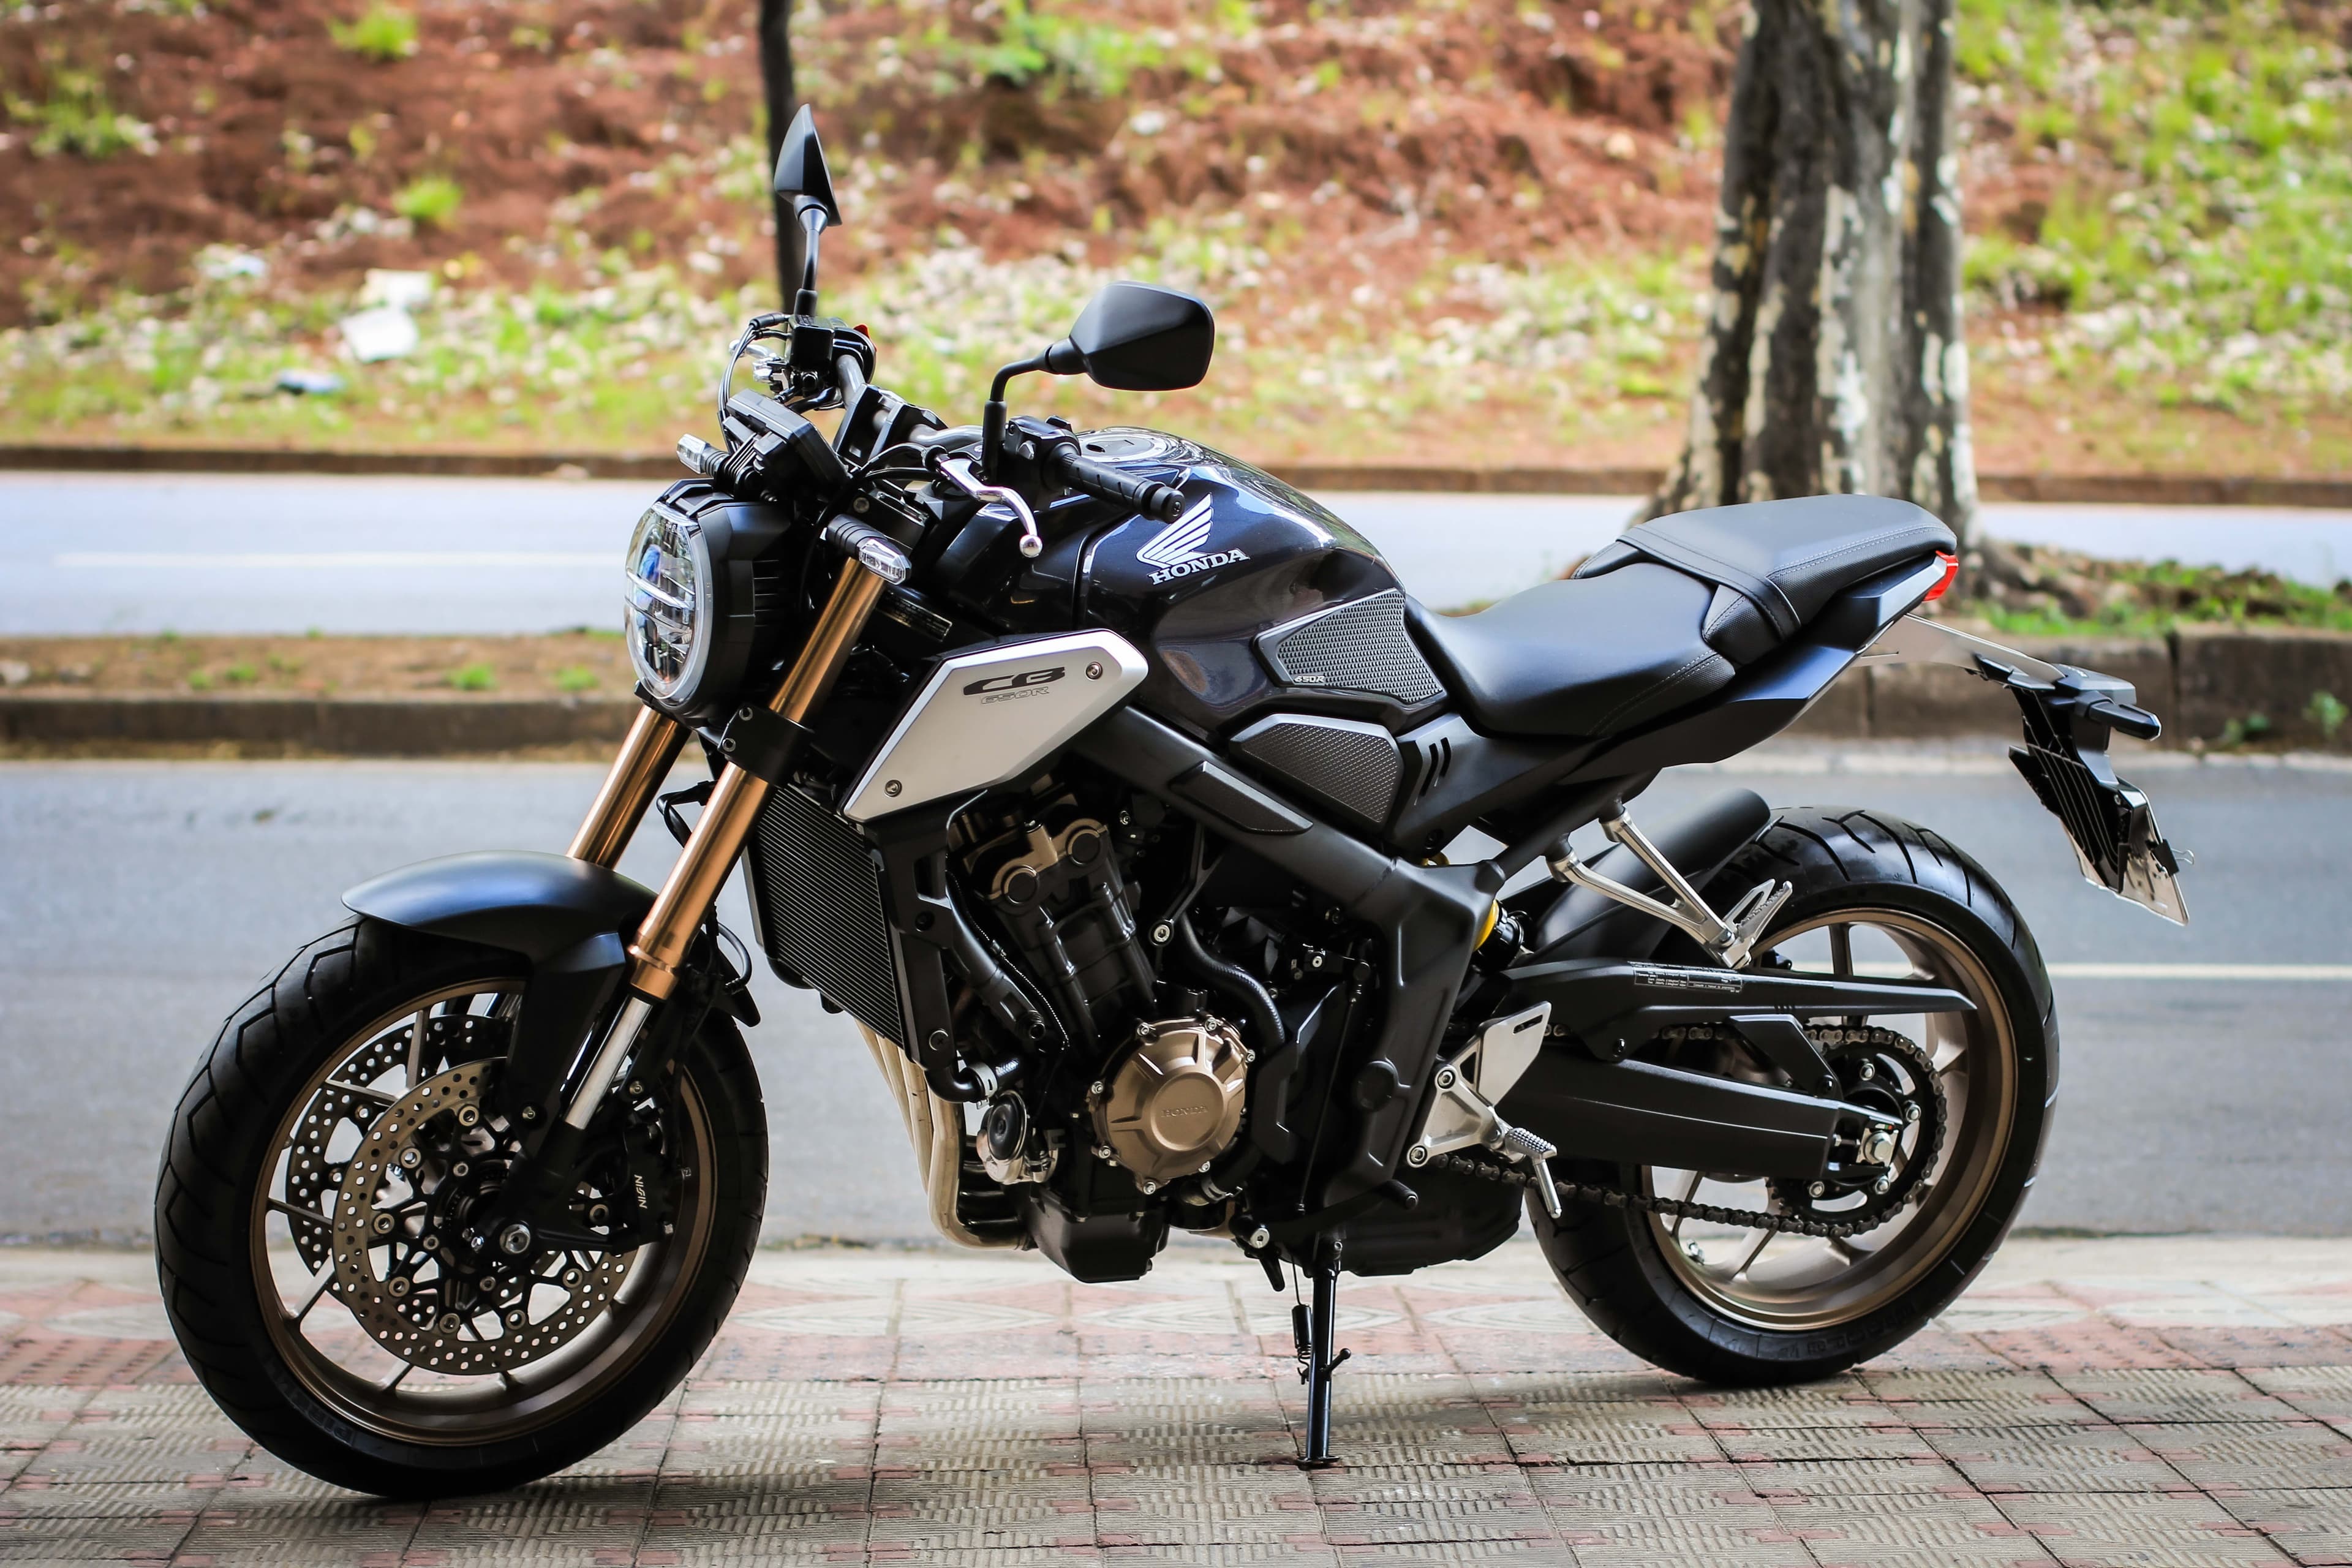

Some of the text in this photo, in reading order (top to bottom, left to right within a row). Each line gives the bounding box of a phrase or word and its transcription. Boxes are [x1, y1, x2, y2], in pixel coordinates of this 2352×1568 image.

[1148, 548, 1251, 585] HONDA
[963, 666, 1065, 695] CB
[981, 687, 1049, 704] 650R
[1161, 1105, 1208, 1118] HONDA
[634, 1174, 647, 1209] NISSIN
